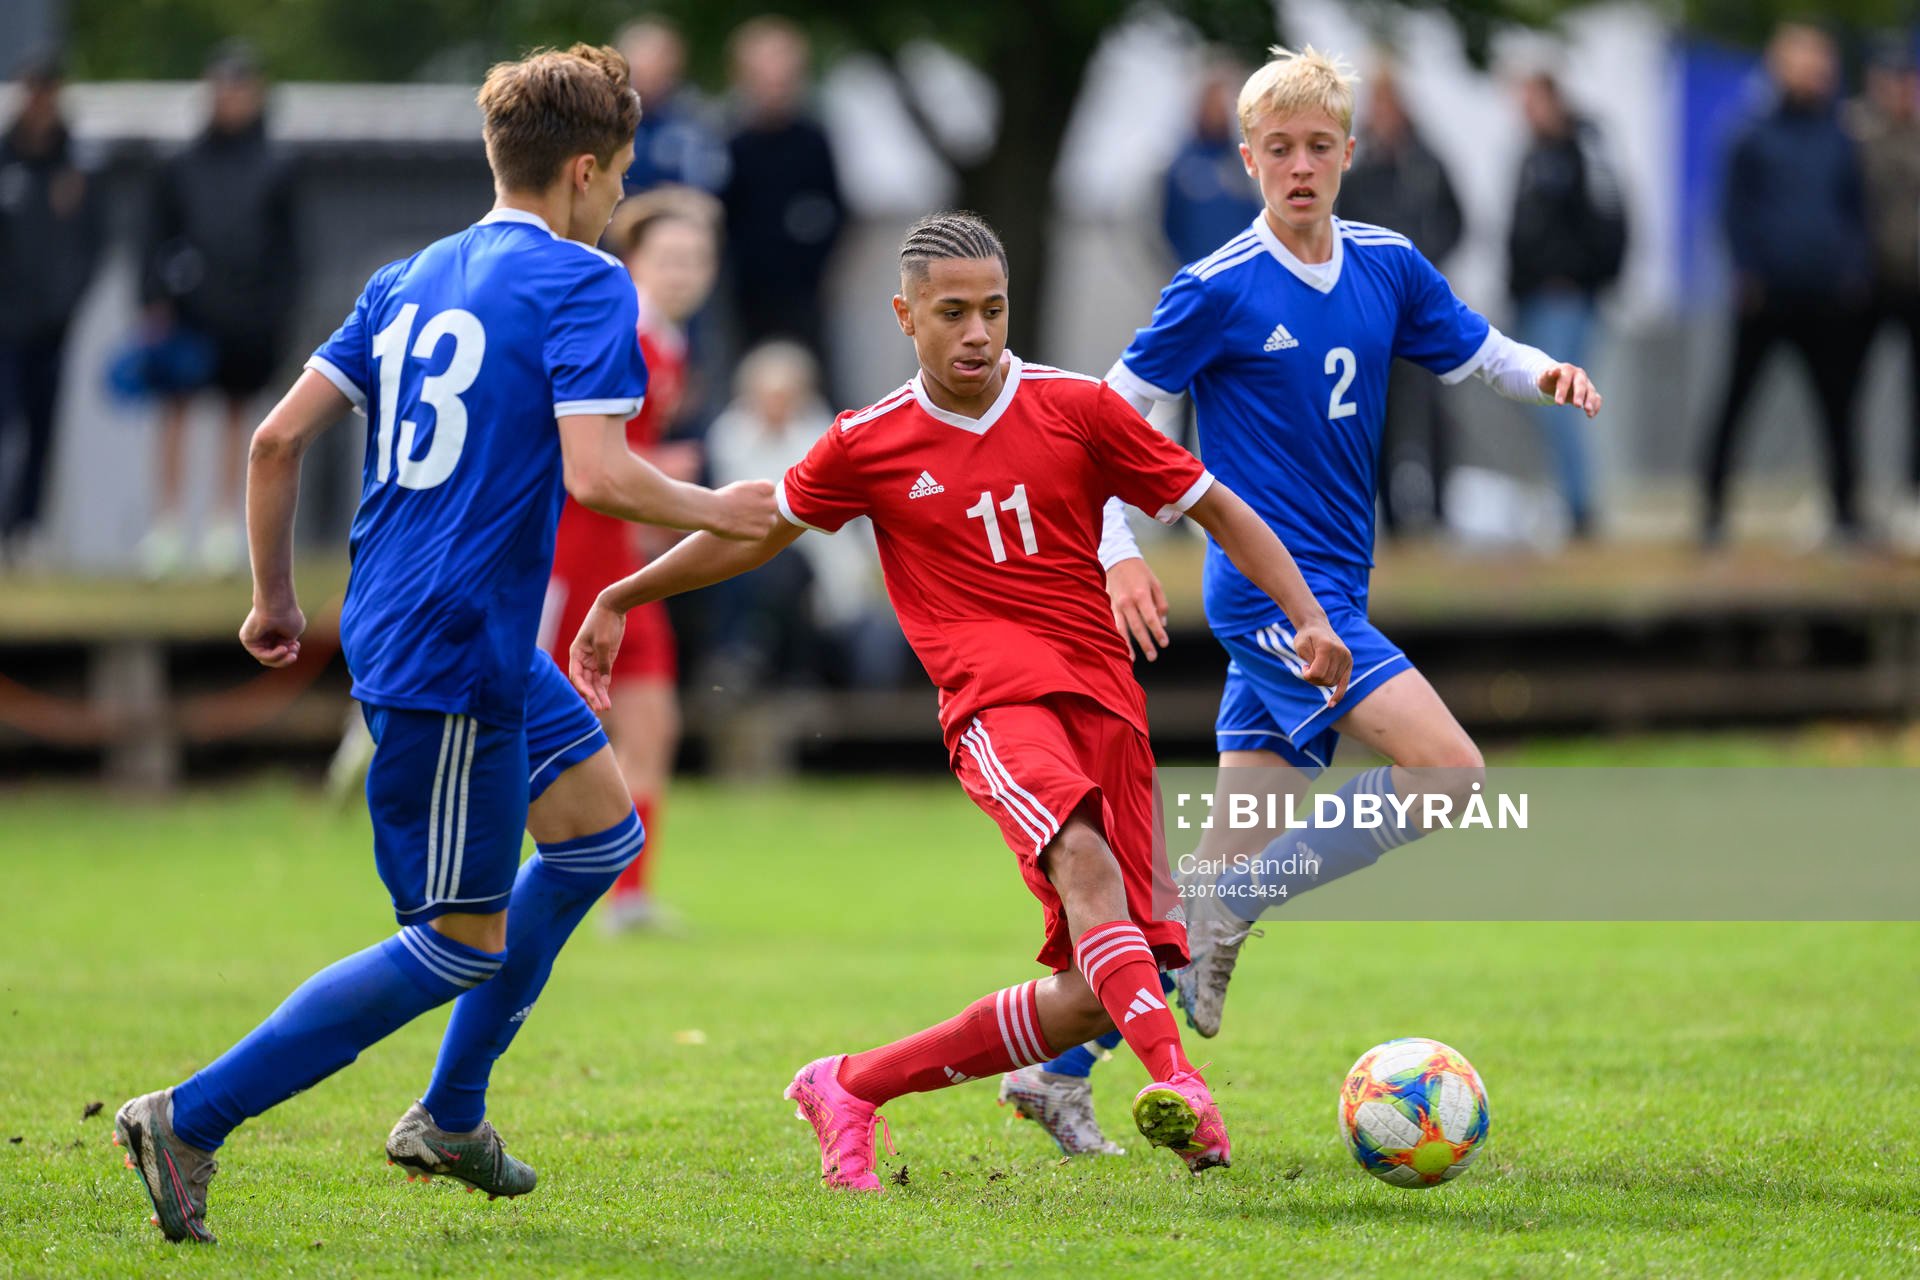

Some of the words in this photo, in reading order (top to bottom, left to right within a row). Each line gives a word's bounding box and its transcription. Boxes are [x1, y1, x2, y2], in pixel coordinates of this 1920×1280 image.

[1263, 338, 1299, 352] adidas
[372, 302, 486, 491] 13
[1324, 346, 1357, 420] 2
[908, 485, 945, 499] adidas
[966, 484, 1039, 564] 11
